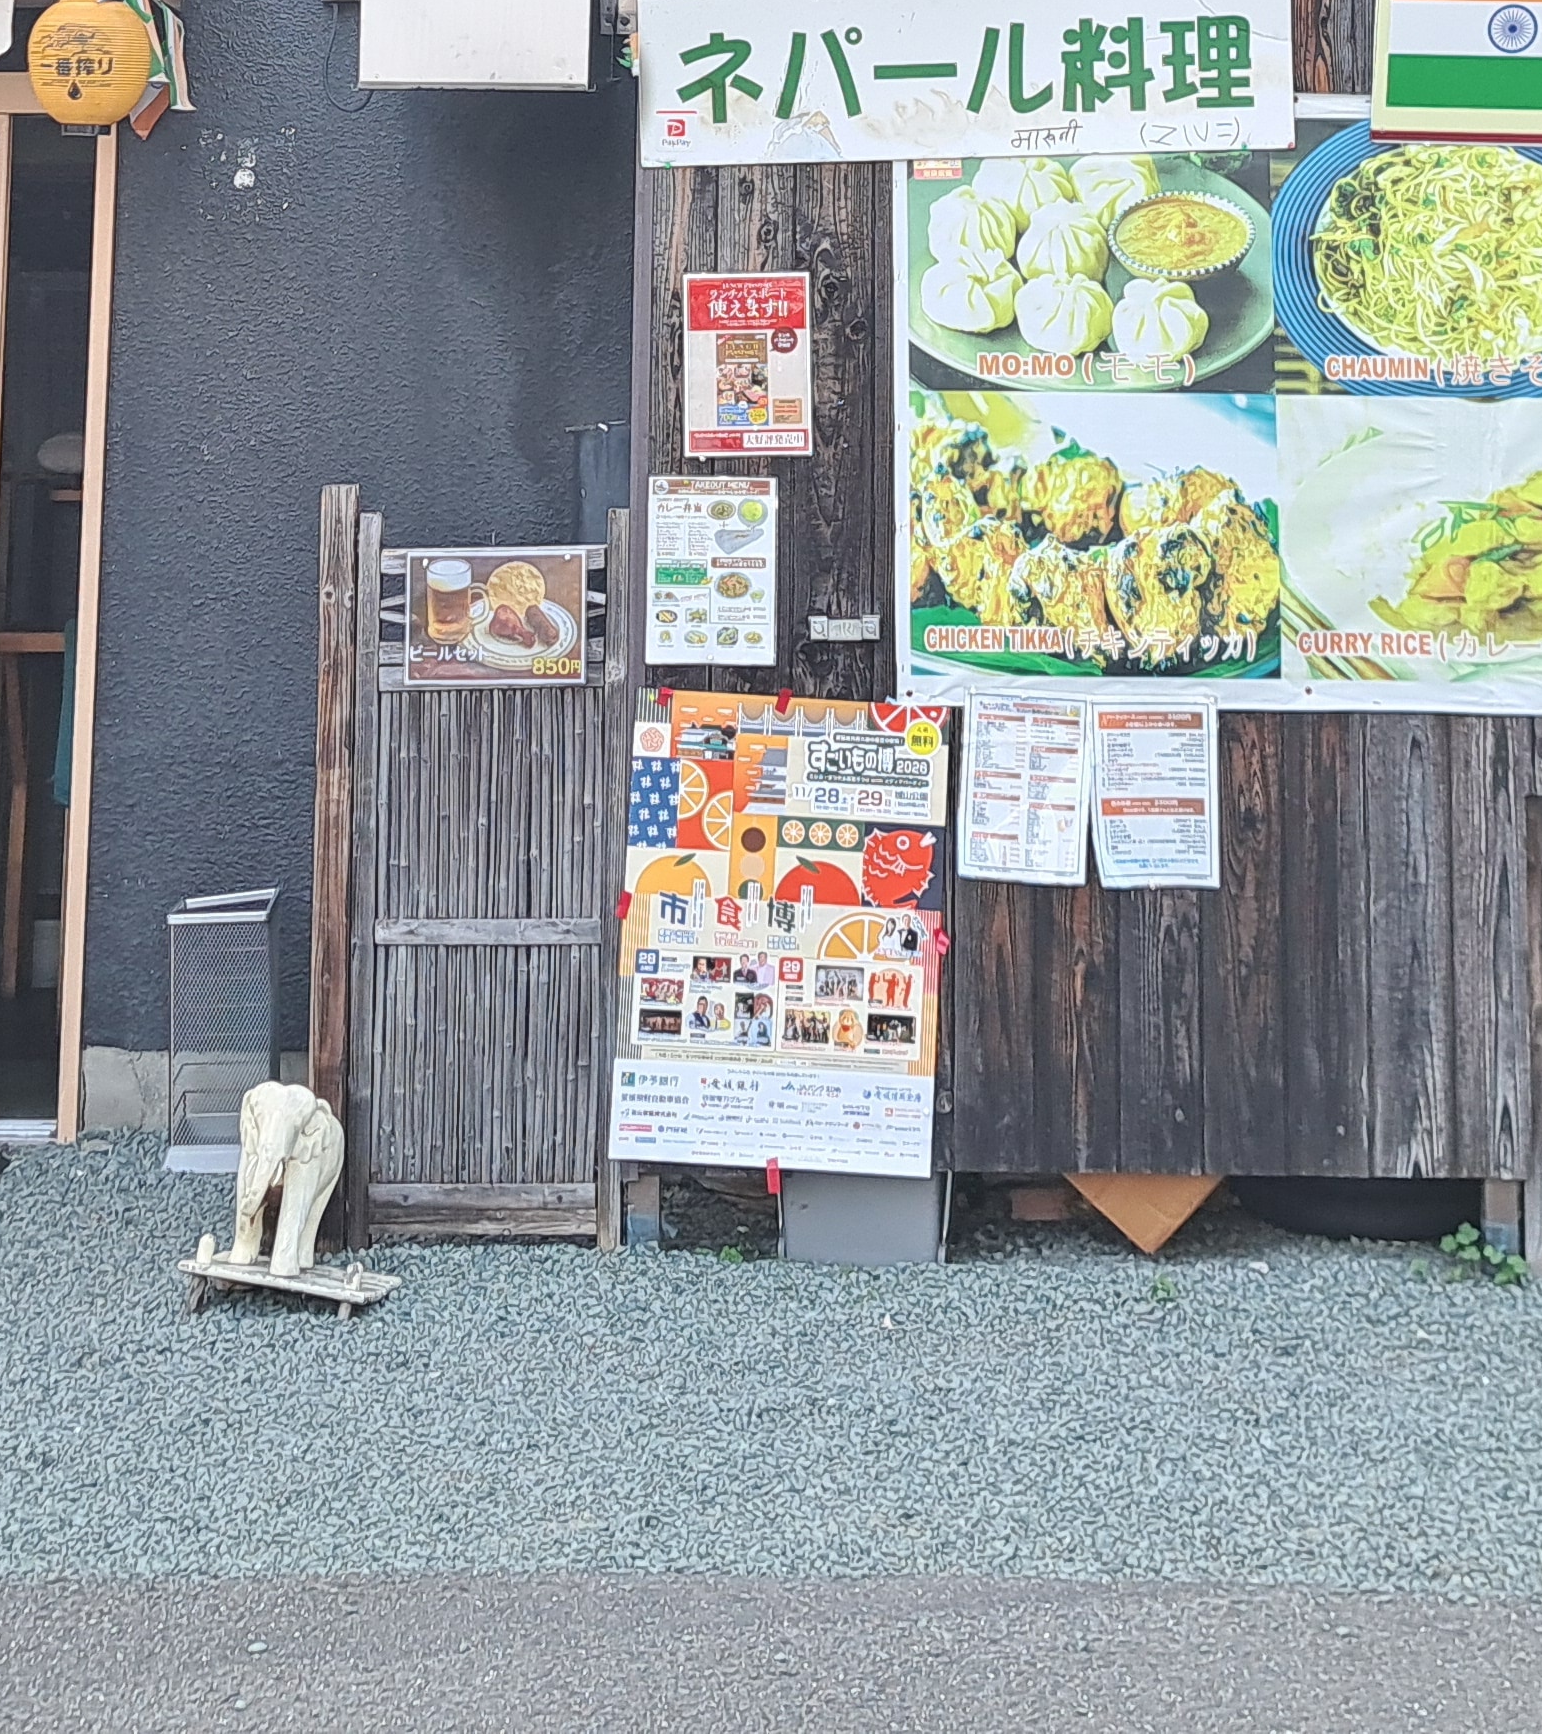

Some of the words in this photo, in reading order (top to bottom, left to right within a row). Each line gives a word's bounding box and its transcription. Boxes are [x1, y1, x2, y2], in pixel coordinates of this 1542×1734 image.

[676, 15, 1256, 124] ネパール料理
[1324, 355, 1430, 382] CHAUMIN
[408, 644, 488, 662] ビールセット
[925, 625, 1006, 654] CHICKEN
[1007, 626, 1062, 652] TIKKA
[1297, 629, 1374, 656] CURRY
[1380, 629, 1432, 657] RICE
[531, 656, 582, 676] 850円
